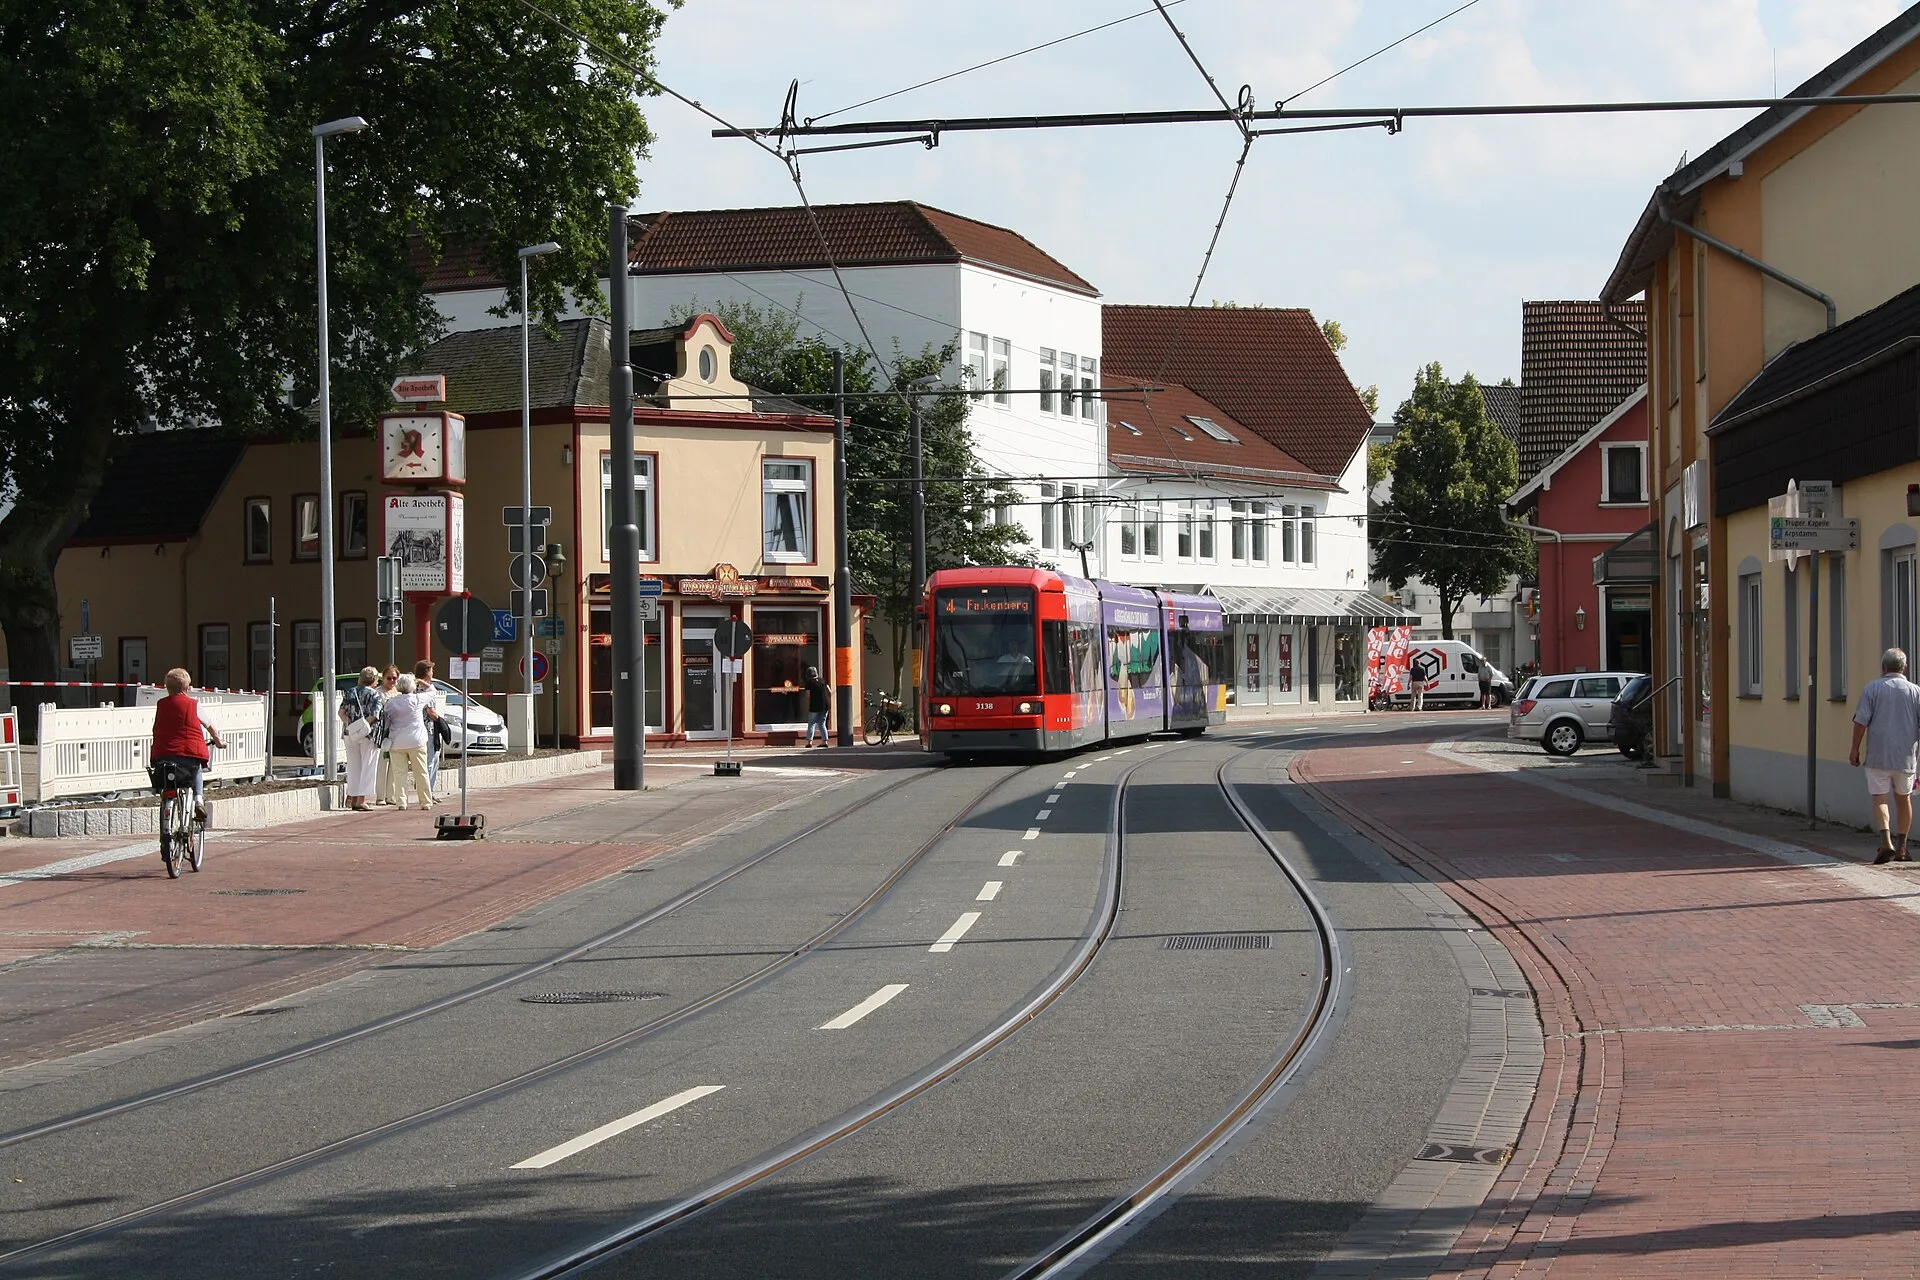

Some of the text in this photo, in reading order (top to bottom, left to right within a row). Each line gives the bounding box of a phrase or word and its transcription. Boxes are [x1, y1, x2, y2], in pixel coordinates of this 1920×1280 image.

[389, 498, 409, 508] Alte
[412, 499, 445, 508] Apotheke
[1807, 520, 1830, 528] Kapelle
[946, 599, 1029, 613] 4 Fakenberg
